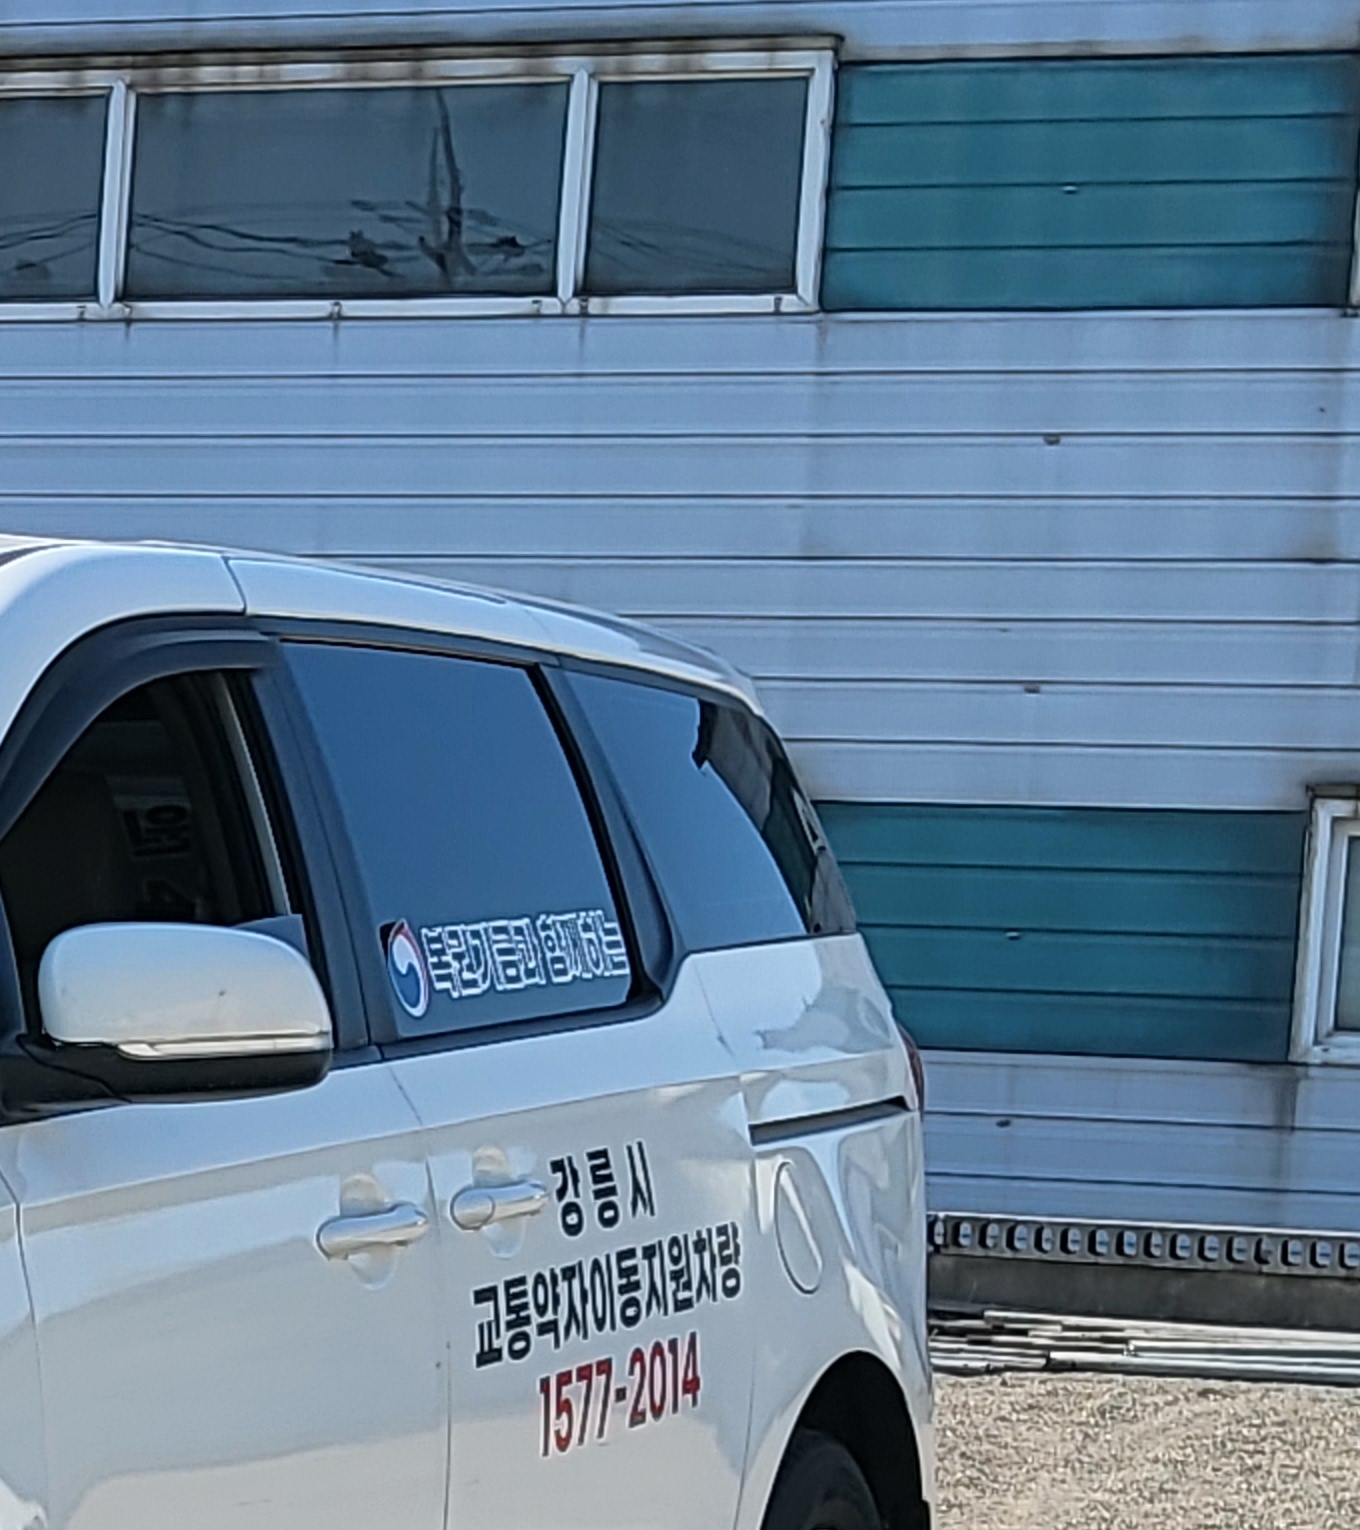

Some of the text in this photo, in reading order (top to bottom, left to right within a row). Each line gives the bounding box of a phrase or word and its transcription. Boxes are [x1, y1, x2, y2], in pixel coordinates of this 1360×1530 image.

[420, 908, 631, 999] 복권기금과 함께하는
[548, 1140, 656, 1237] 강릉시
[472, 1220, 742, 1369] 교통약자이동지원차량
[538, 1330, 702, 1458] 1577-2014
